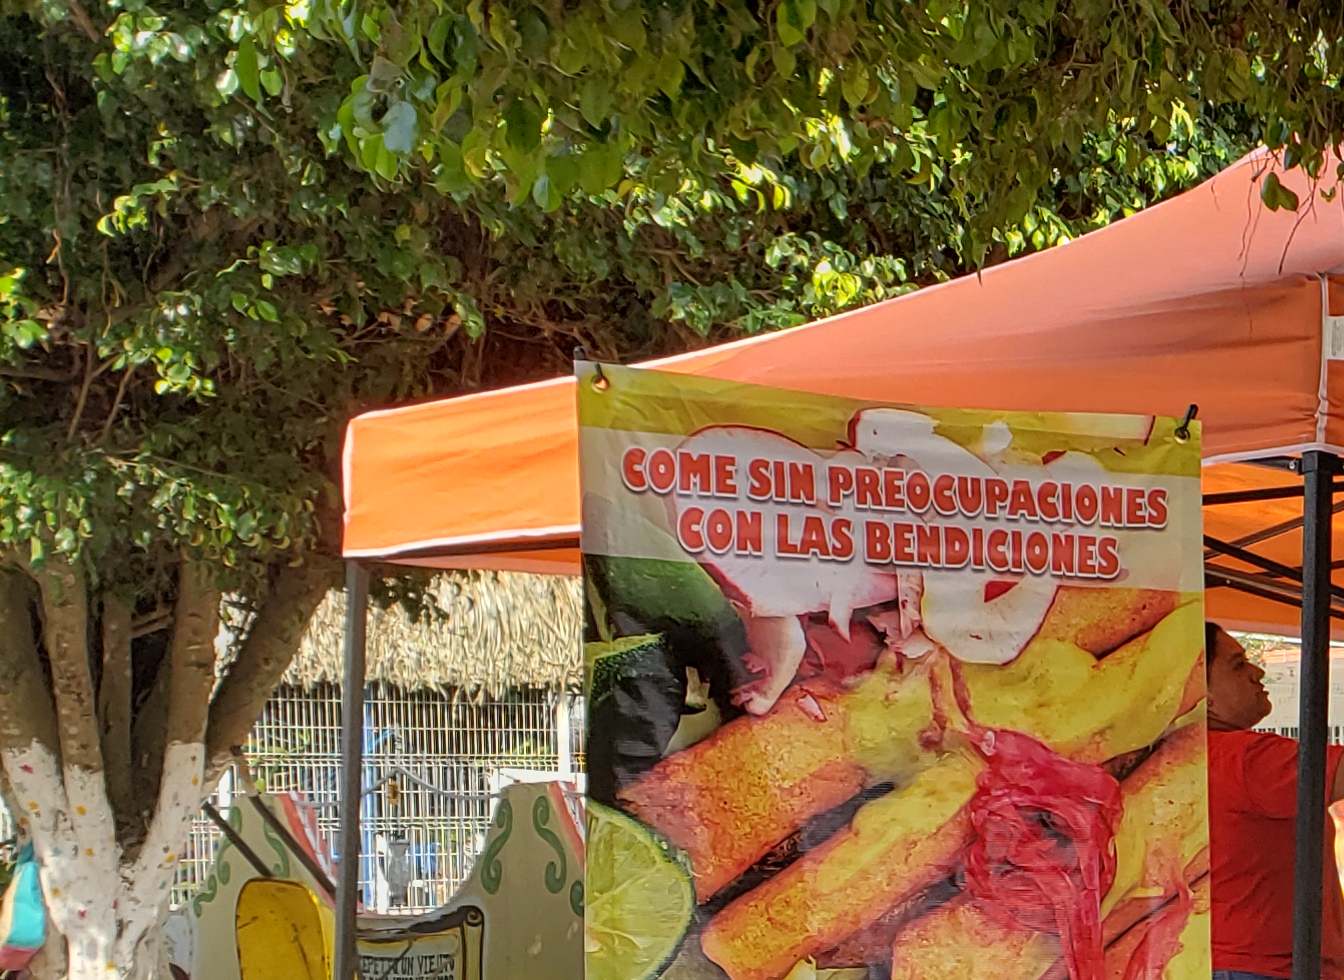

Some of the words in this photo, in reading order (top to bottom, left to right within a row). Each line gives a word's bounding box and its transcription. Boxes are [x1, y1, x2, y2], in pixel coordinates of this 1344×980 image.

[621, 447, 738, 495] COME
[747, 457, 817, 505] SIN
[827, 465, 1170, 529] PREOCUPACIONES
[678, 507, 763, 555] CON
[776, 513, 854, 561] LAS
[864, 519, 1121, 578] BENDICIONES
